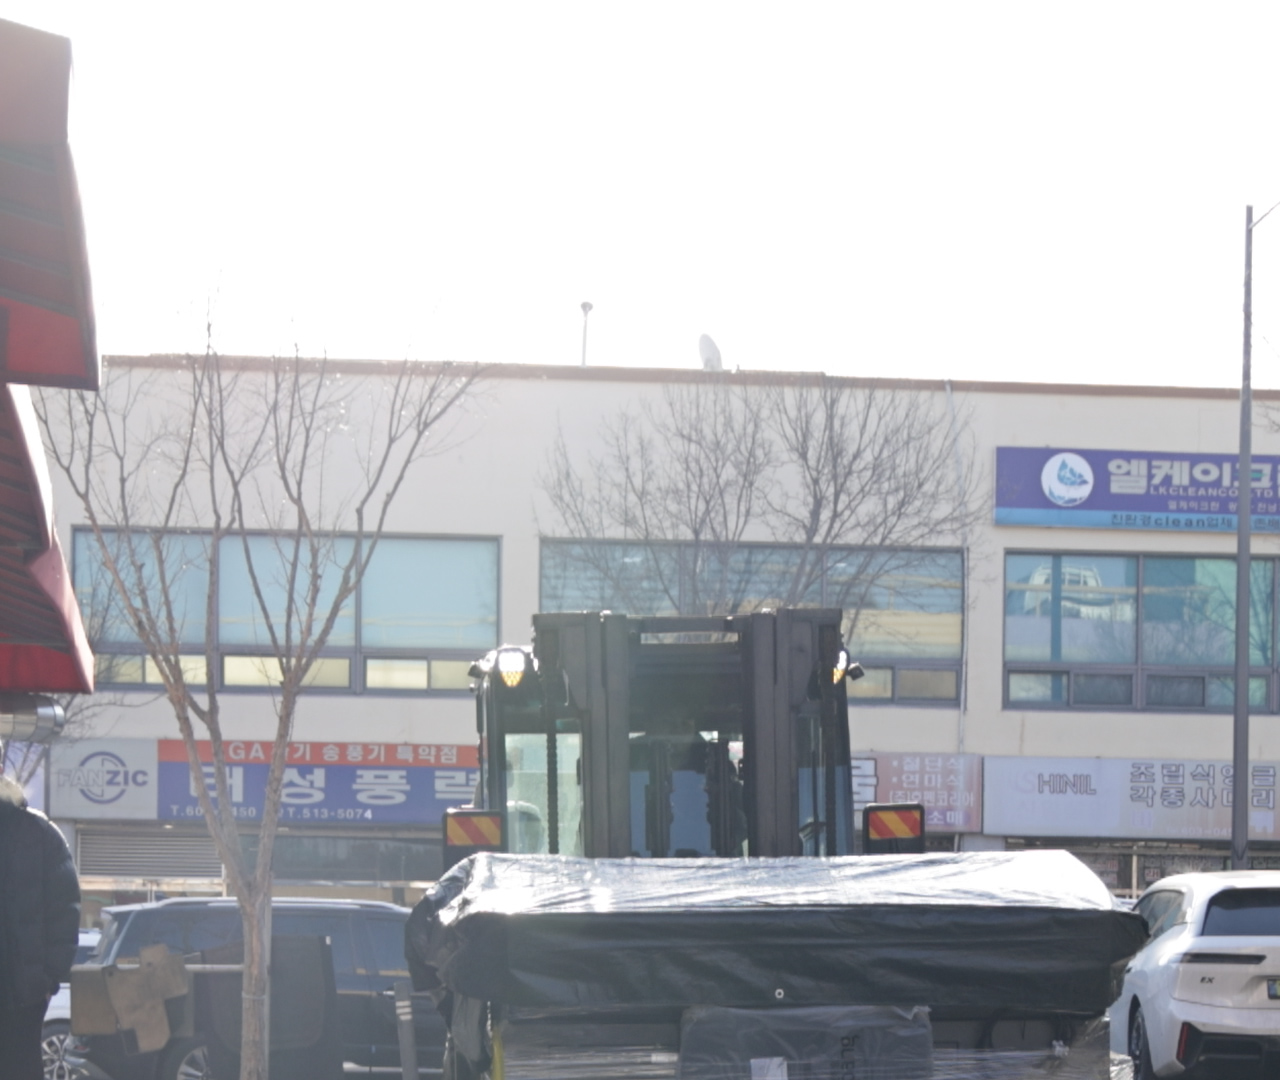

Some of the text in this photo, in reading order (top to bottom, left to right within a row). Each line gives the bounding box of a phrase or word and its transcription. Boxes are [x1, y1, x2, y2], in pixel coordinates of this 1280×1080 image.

[228, 742, 265, 760] GA
[322, 744, 385, 762] 송풍기
[396, 745, 458, 764] 특약점
[57, 768, 149, 787] FANZIC
